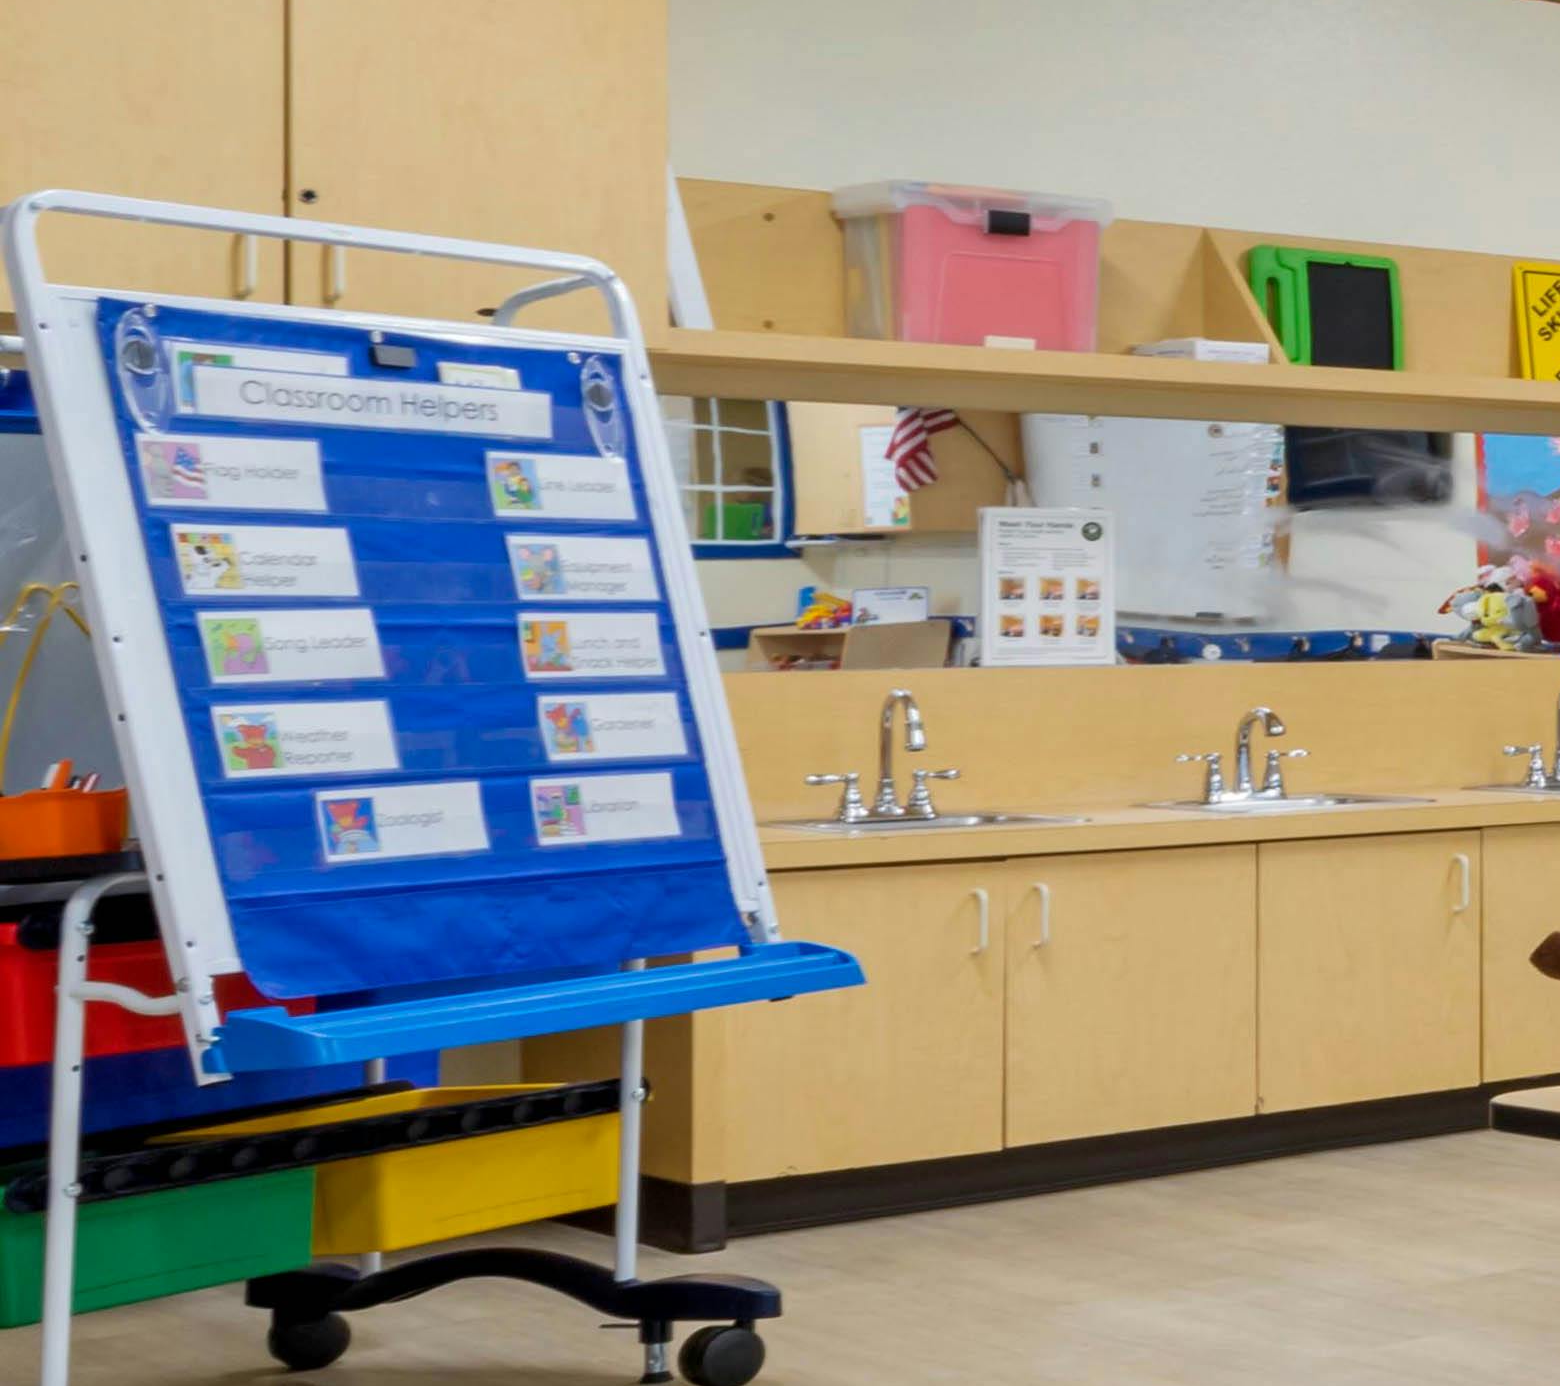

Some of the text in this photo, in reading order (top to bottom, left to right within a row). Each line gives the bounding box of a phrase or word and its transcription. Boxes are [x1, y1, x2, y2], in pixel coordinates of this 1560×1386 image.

[237, 377, 500, 424] Classroom Helpers
[263, 635, 369, 653] Song Leader
